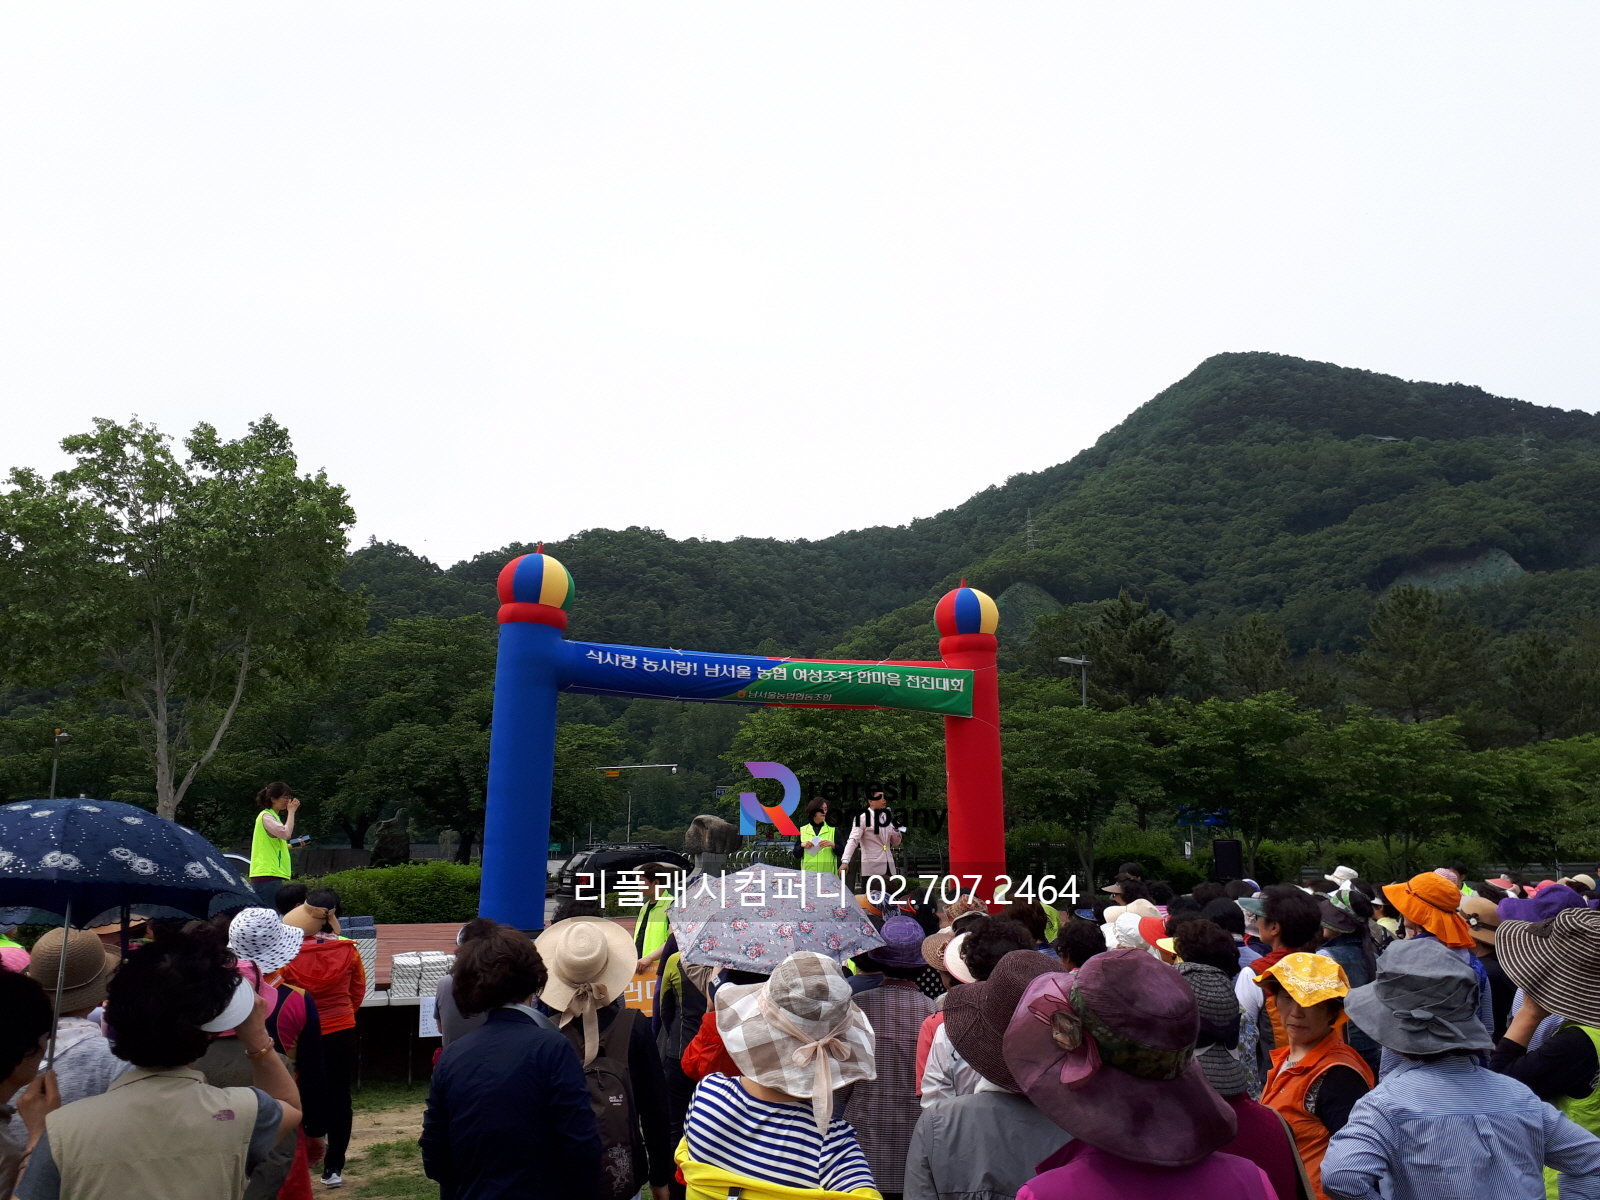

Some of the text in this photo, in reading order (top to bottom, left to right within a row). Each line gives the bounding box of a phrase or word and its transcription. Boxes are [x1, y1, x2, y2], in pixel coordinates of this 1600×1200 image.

[585, 649, 965, 692] 식사랑 농사랑! 남서울 농협 여성조직 한마음 전진대회
[748, 691, 832, 702] 남서울농업협동조합
